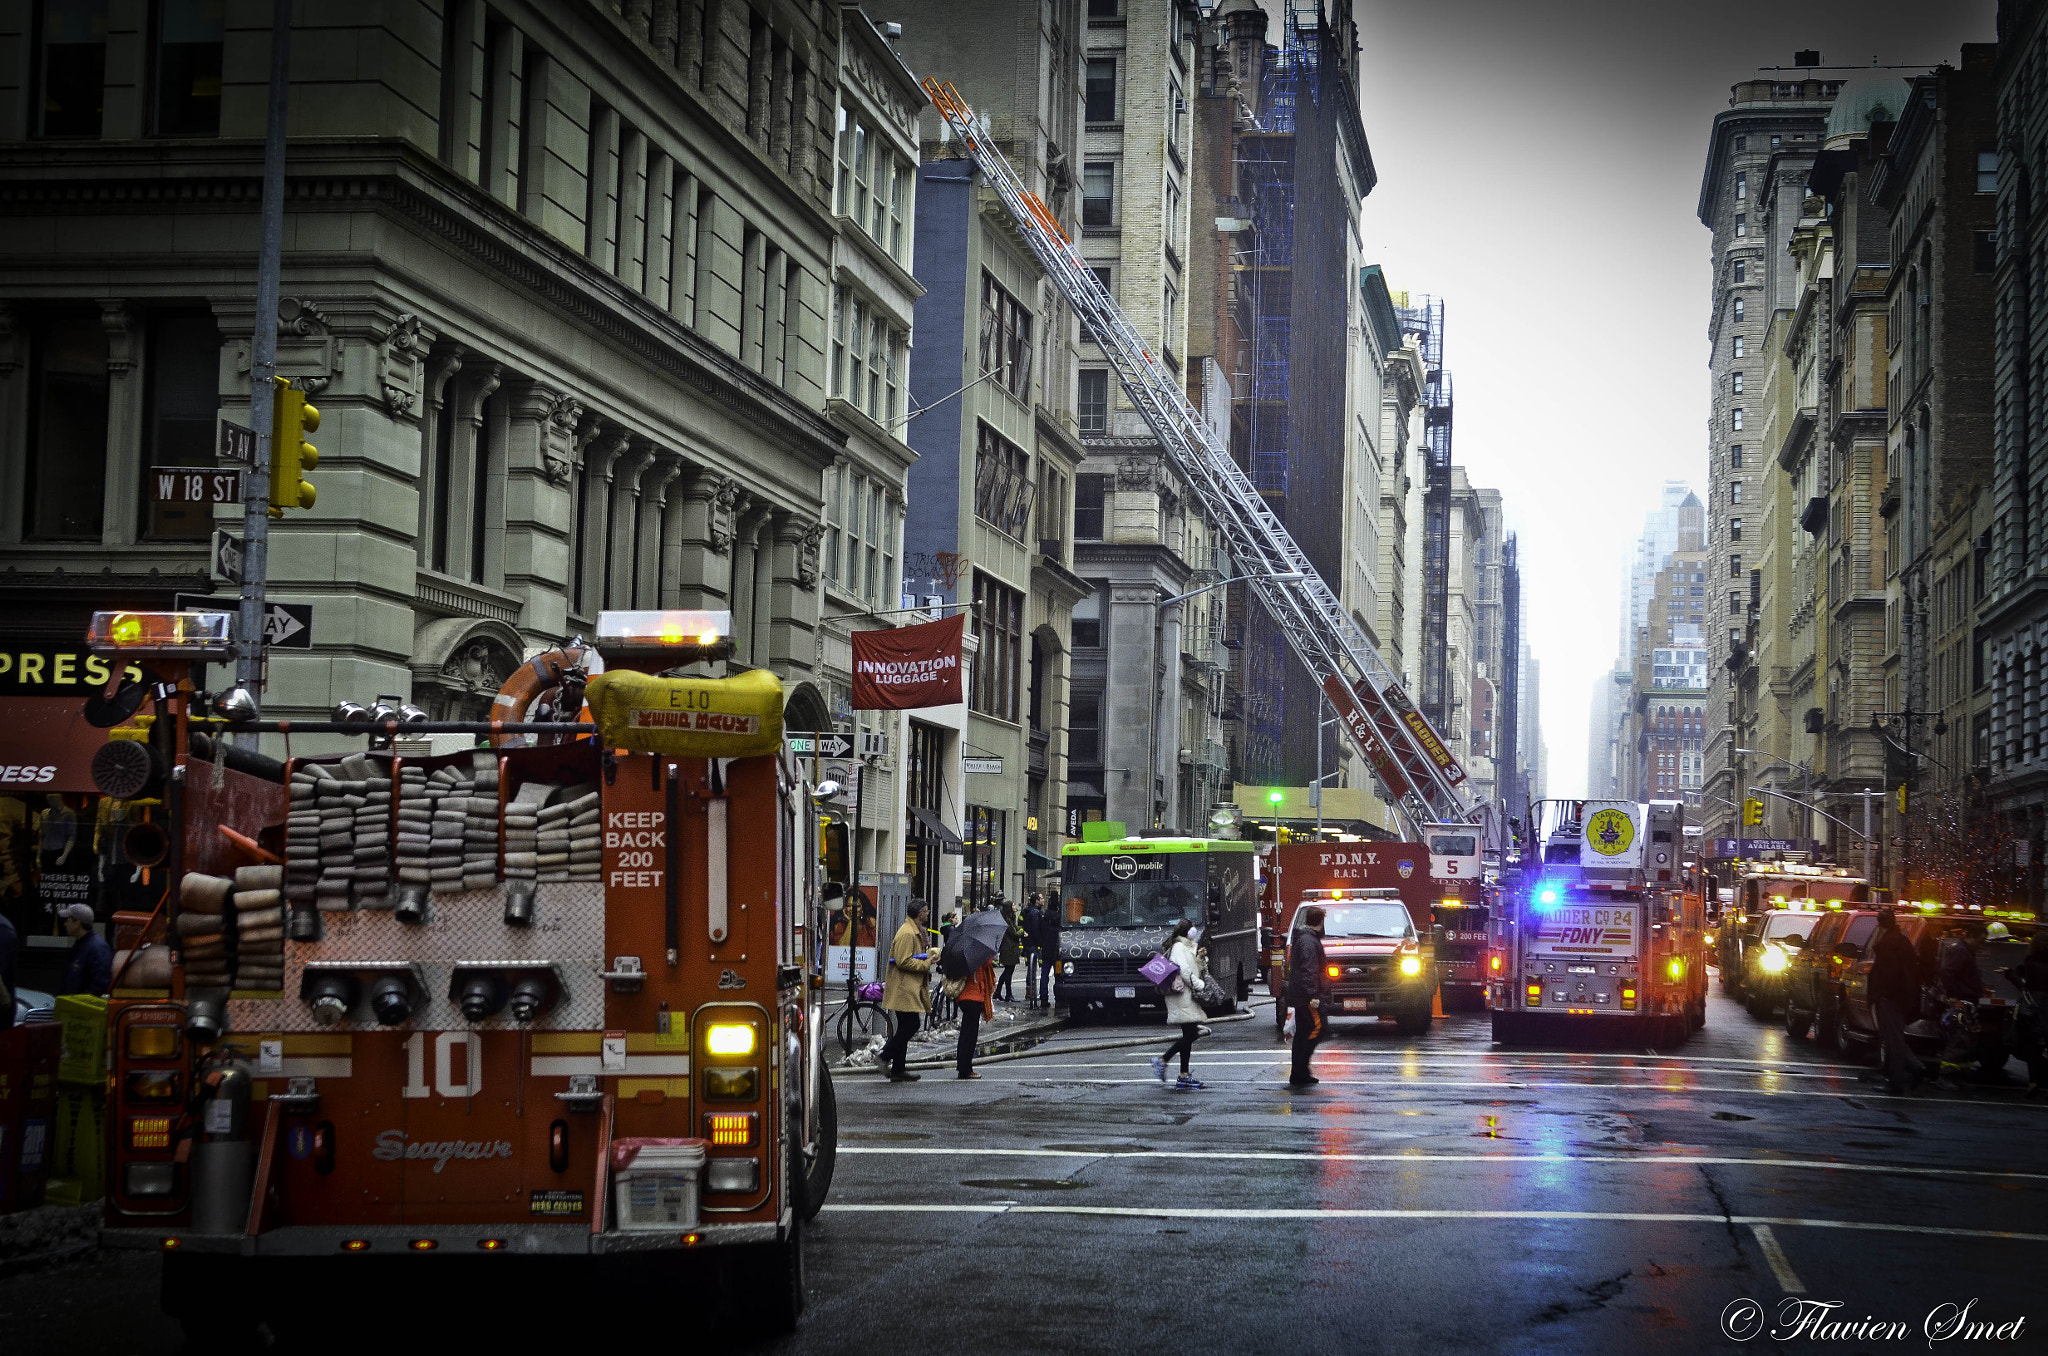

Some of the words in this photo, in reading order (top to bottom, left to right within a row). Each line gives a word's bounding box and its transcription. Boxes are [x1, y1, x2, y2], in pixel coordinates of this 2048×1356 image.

[226, 429, 234, 455] 5
[237, 433, 250, 461] AV
[158, 474, 176, 501] W
[184, 474, 204, 502] 18
[212, 475, 236, 502] ST
[265, 617, 292, 634] AY
[857, 654, 957, 675] INNOVATION
[875, 671, 938, 685] LUGGAGE
[669, 689, 710, 710] E10
[638, 709, 692, 729] KEEP
[695, 712, 750, 733] BACK
[1346, 708, 1360, 727] H
[1355, 722, 1366, 739] &
[789, 740, 812, 751] ONE
[821, 741, 844, 752] WAY
[1404, 712, 1450, 766] LADDER
[1443, 763, 1462, 782] 3
[608, 811, 665, 829] KEEP
[1595, 811, 1625, 821] LADDER
[605, 831, 666, 848] BACK
[1747, 843, 1791, 851] AVAILABLE
[618, 851, 654, 868] 200
[1138, 861, 1163, 870] mobile
[1319, 852, 1382, 866] F.D.N.Y.
[1446, 860, 1459, 875] 5
[40, 873, 76, 882] THERE'S
[76, 873, 91, 883] NO
[610, 870, 664, 888] FEET
[1333, 868, 1361, 879] R.A.C.
[1363, 868, 1369, 878] 1
[40, 882, 71, 891] WRONG
[71, 882, 90, 891] WAY
[40, 890, 52, 898] TO
[53, 890, 78, 899] WEAR
[80, 891, 89, 899] IT
[1543, 909, 1591, 925] ADDER
[1613, 910, 1632, 926] 24
[1459, 932, 1472, 940] 200
[1473, 933, 1488, 941] FEE
[1560, 927, 1605, 944] FDNY
[402, 1030, 482, 1098] 10
[372, 1129, 513, 1175] Seagrave
